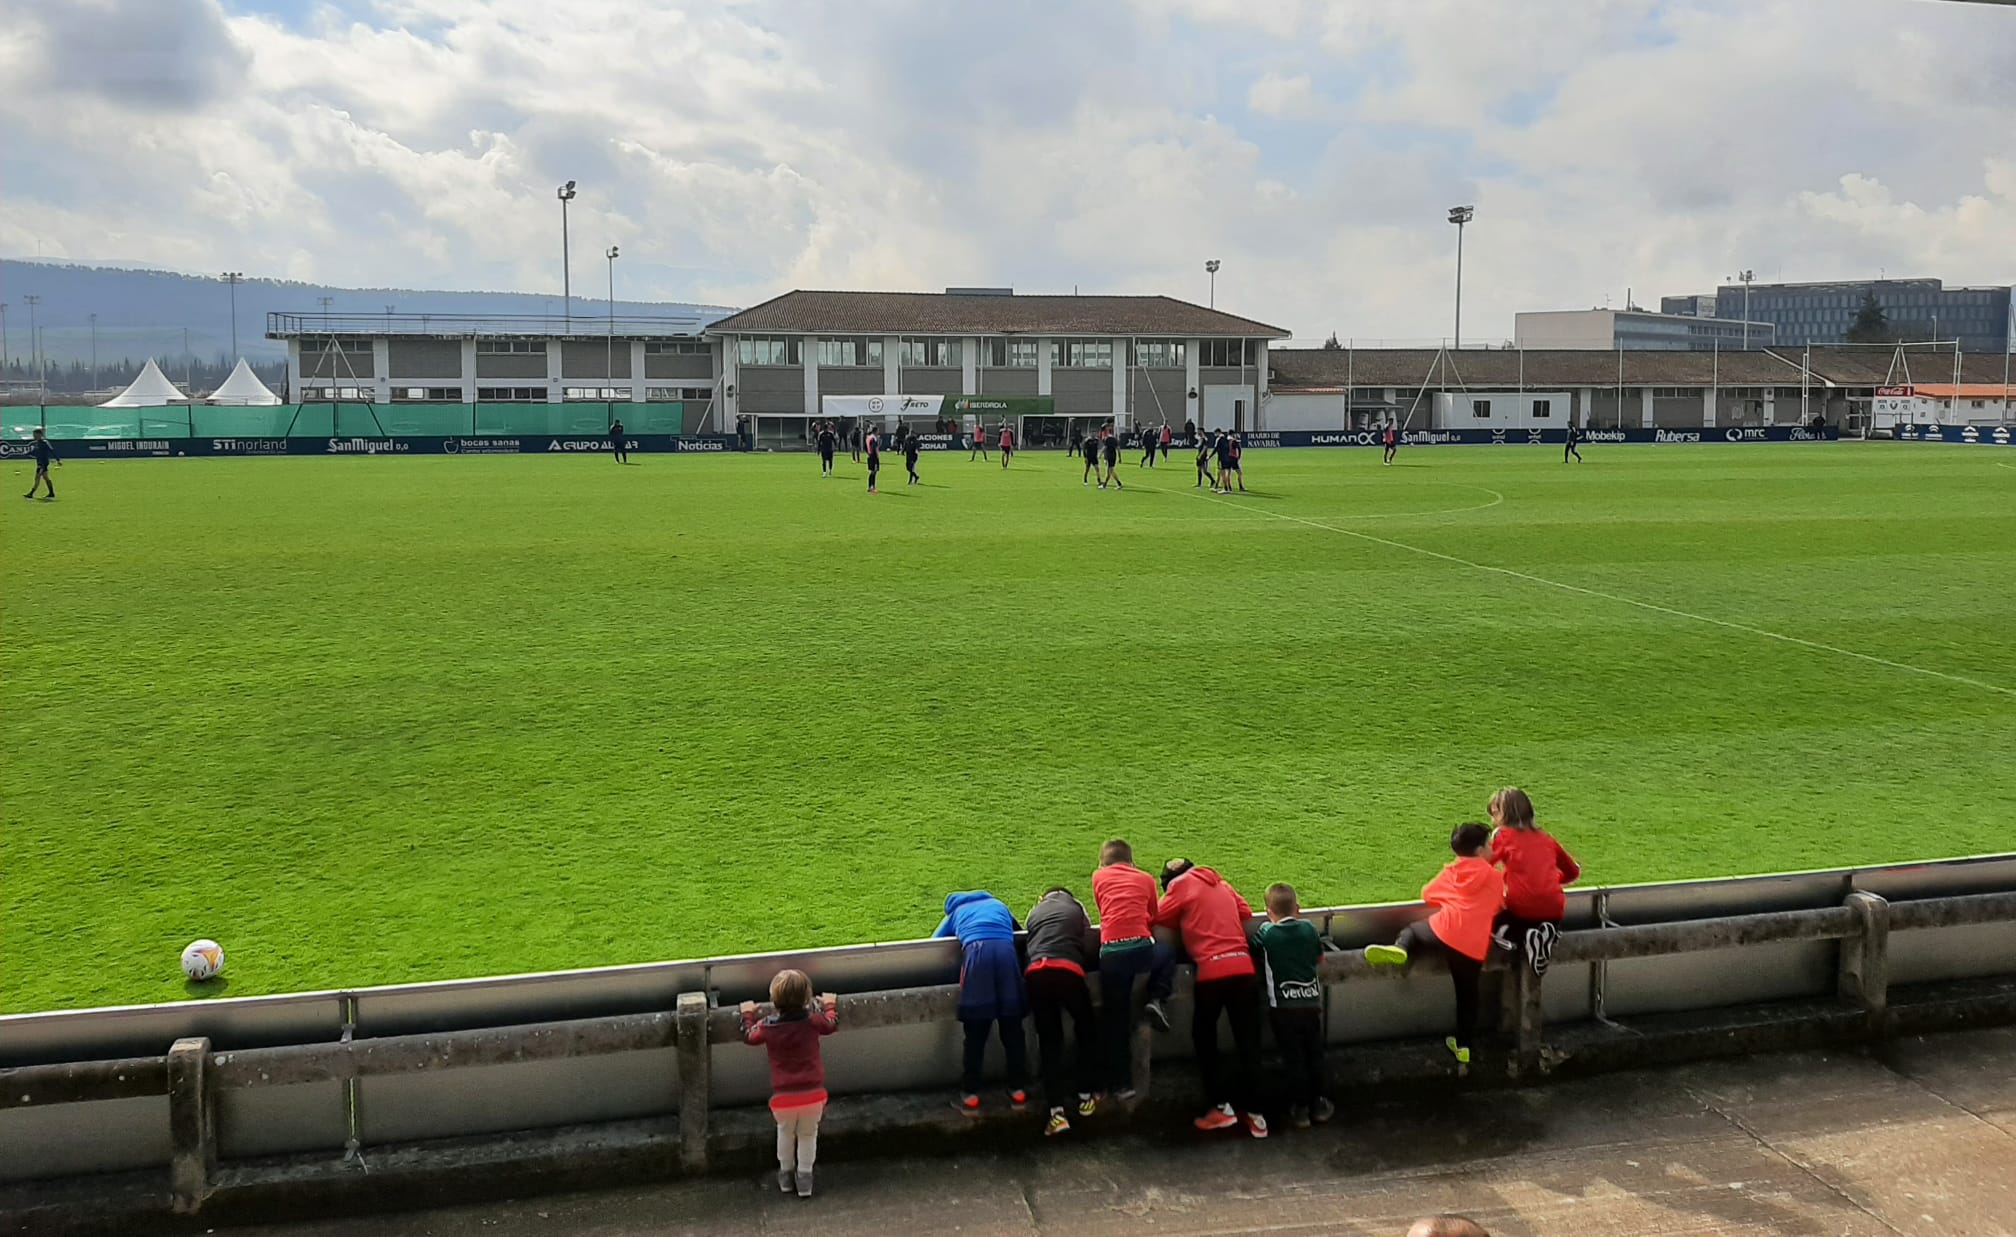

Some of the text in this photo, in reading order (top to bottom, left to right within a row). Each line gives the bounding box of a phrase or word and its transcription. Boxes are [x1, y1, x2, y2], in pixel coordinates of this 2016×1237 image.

[1585, 430, 1626, 442] Mobekip
[1744, 429, 1765, 438] mrc
[678, 440, 722, 450] Noticias
[1247, 440, 1280, 448] NAVARRA
